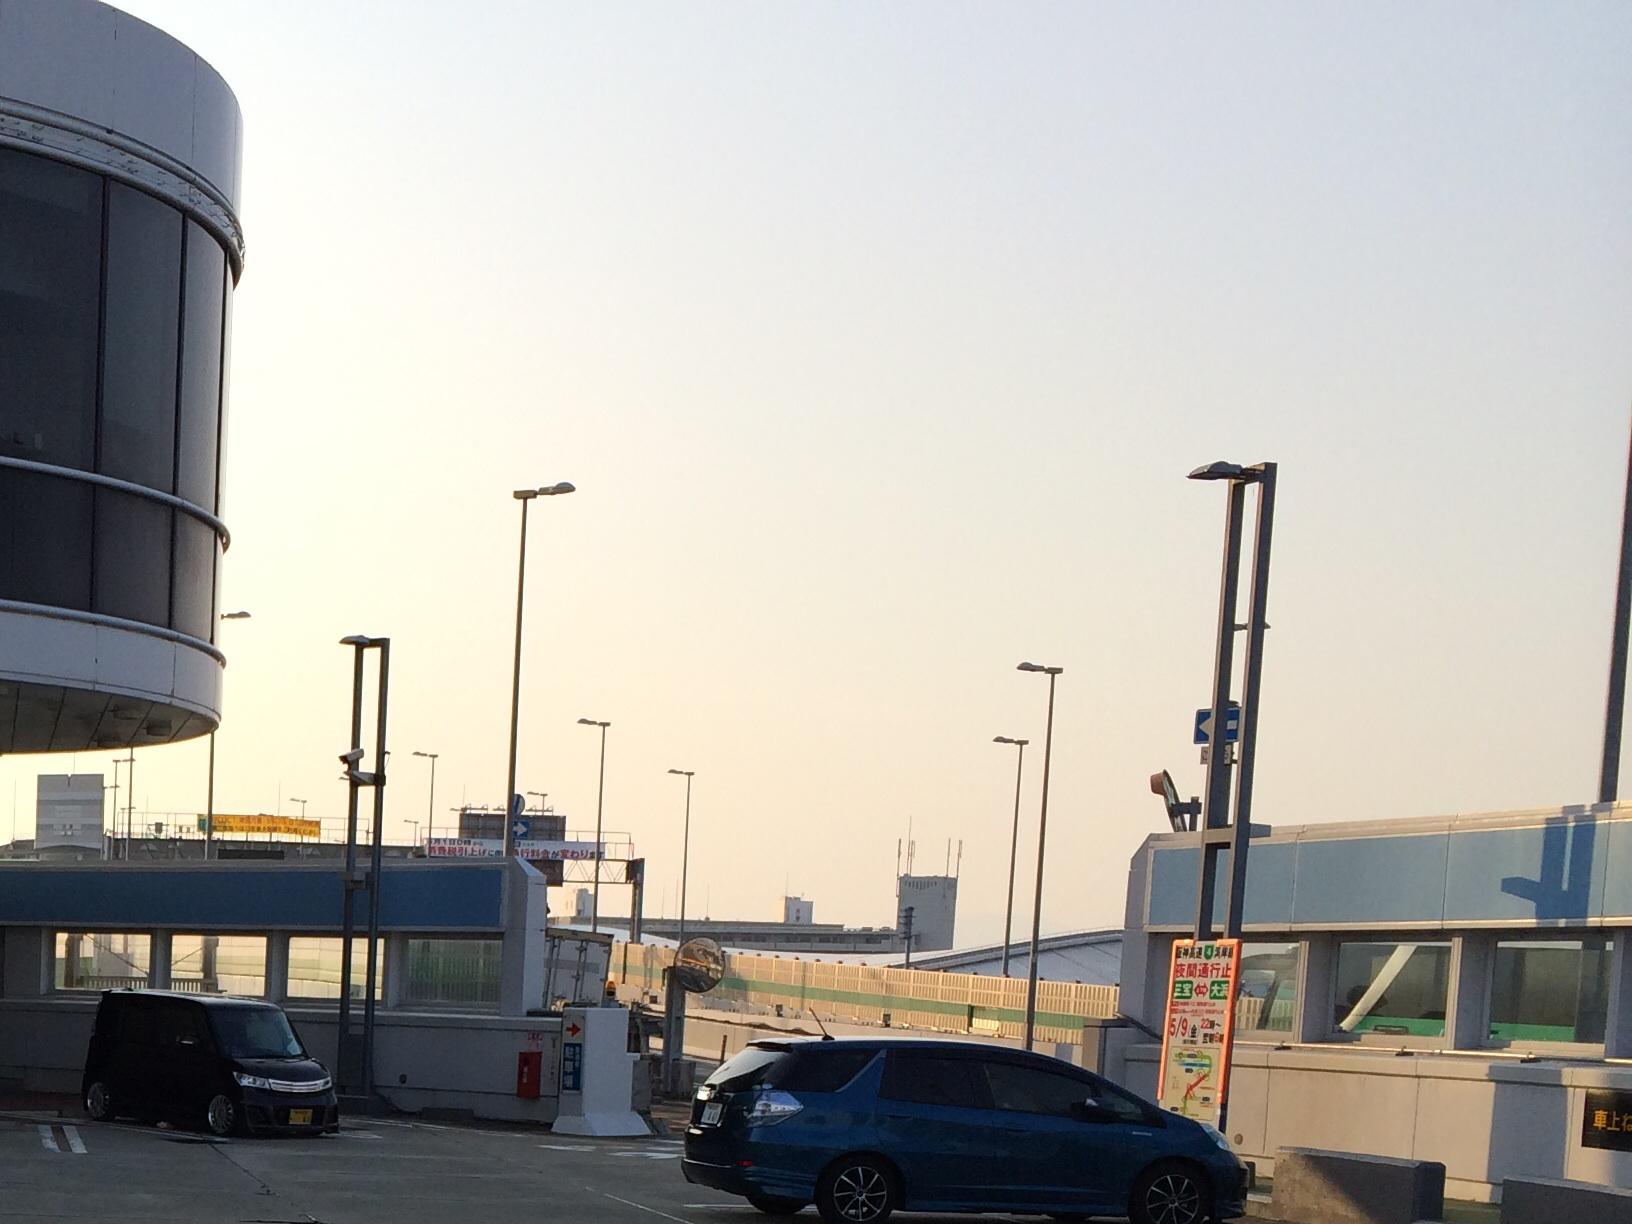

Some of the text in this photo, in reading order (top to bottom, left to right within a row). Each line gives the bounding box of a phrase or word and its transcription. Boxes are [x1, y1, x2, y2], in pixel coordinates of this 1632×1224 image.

[1175, 963, 1231, 978] 夜間通行止
